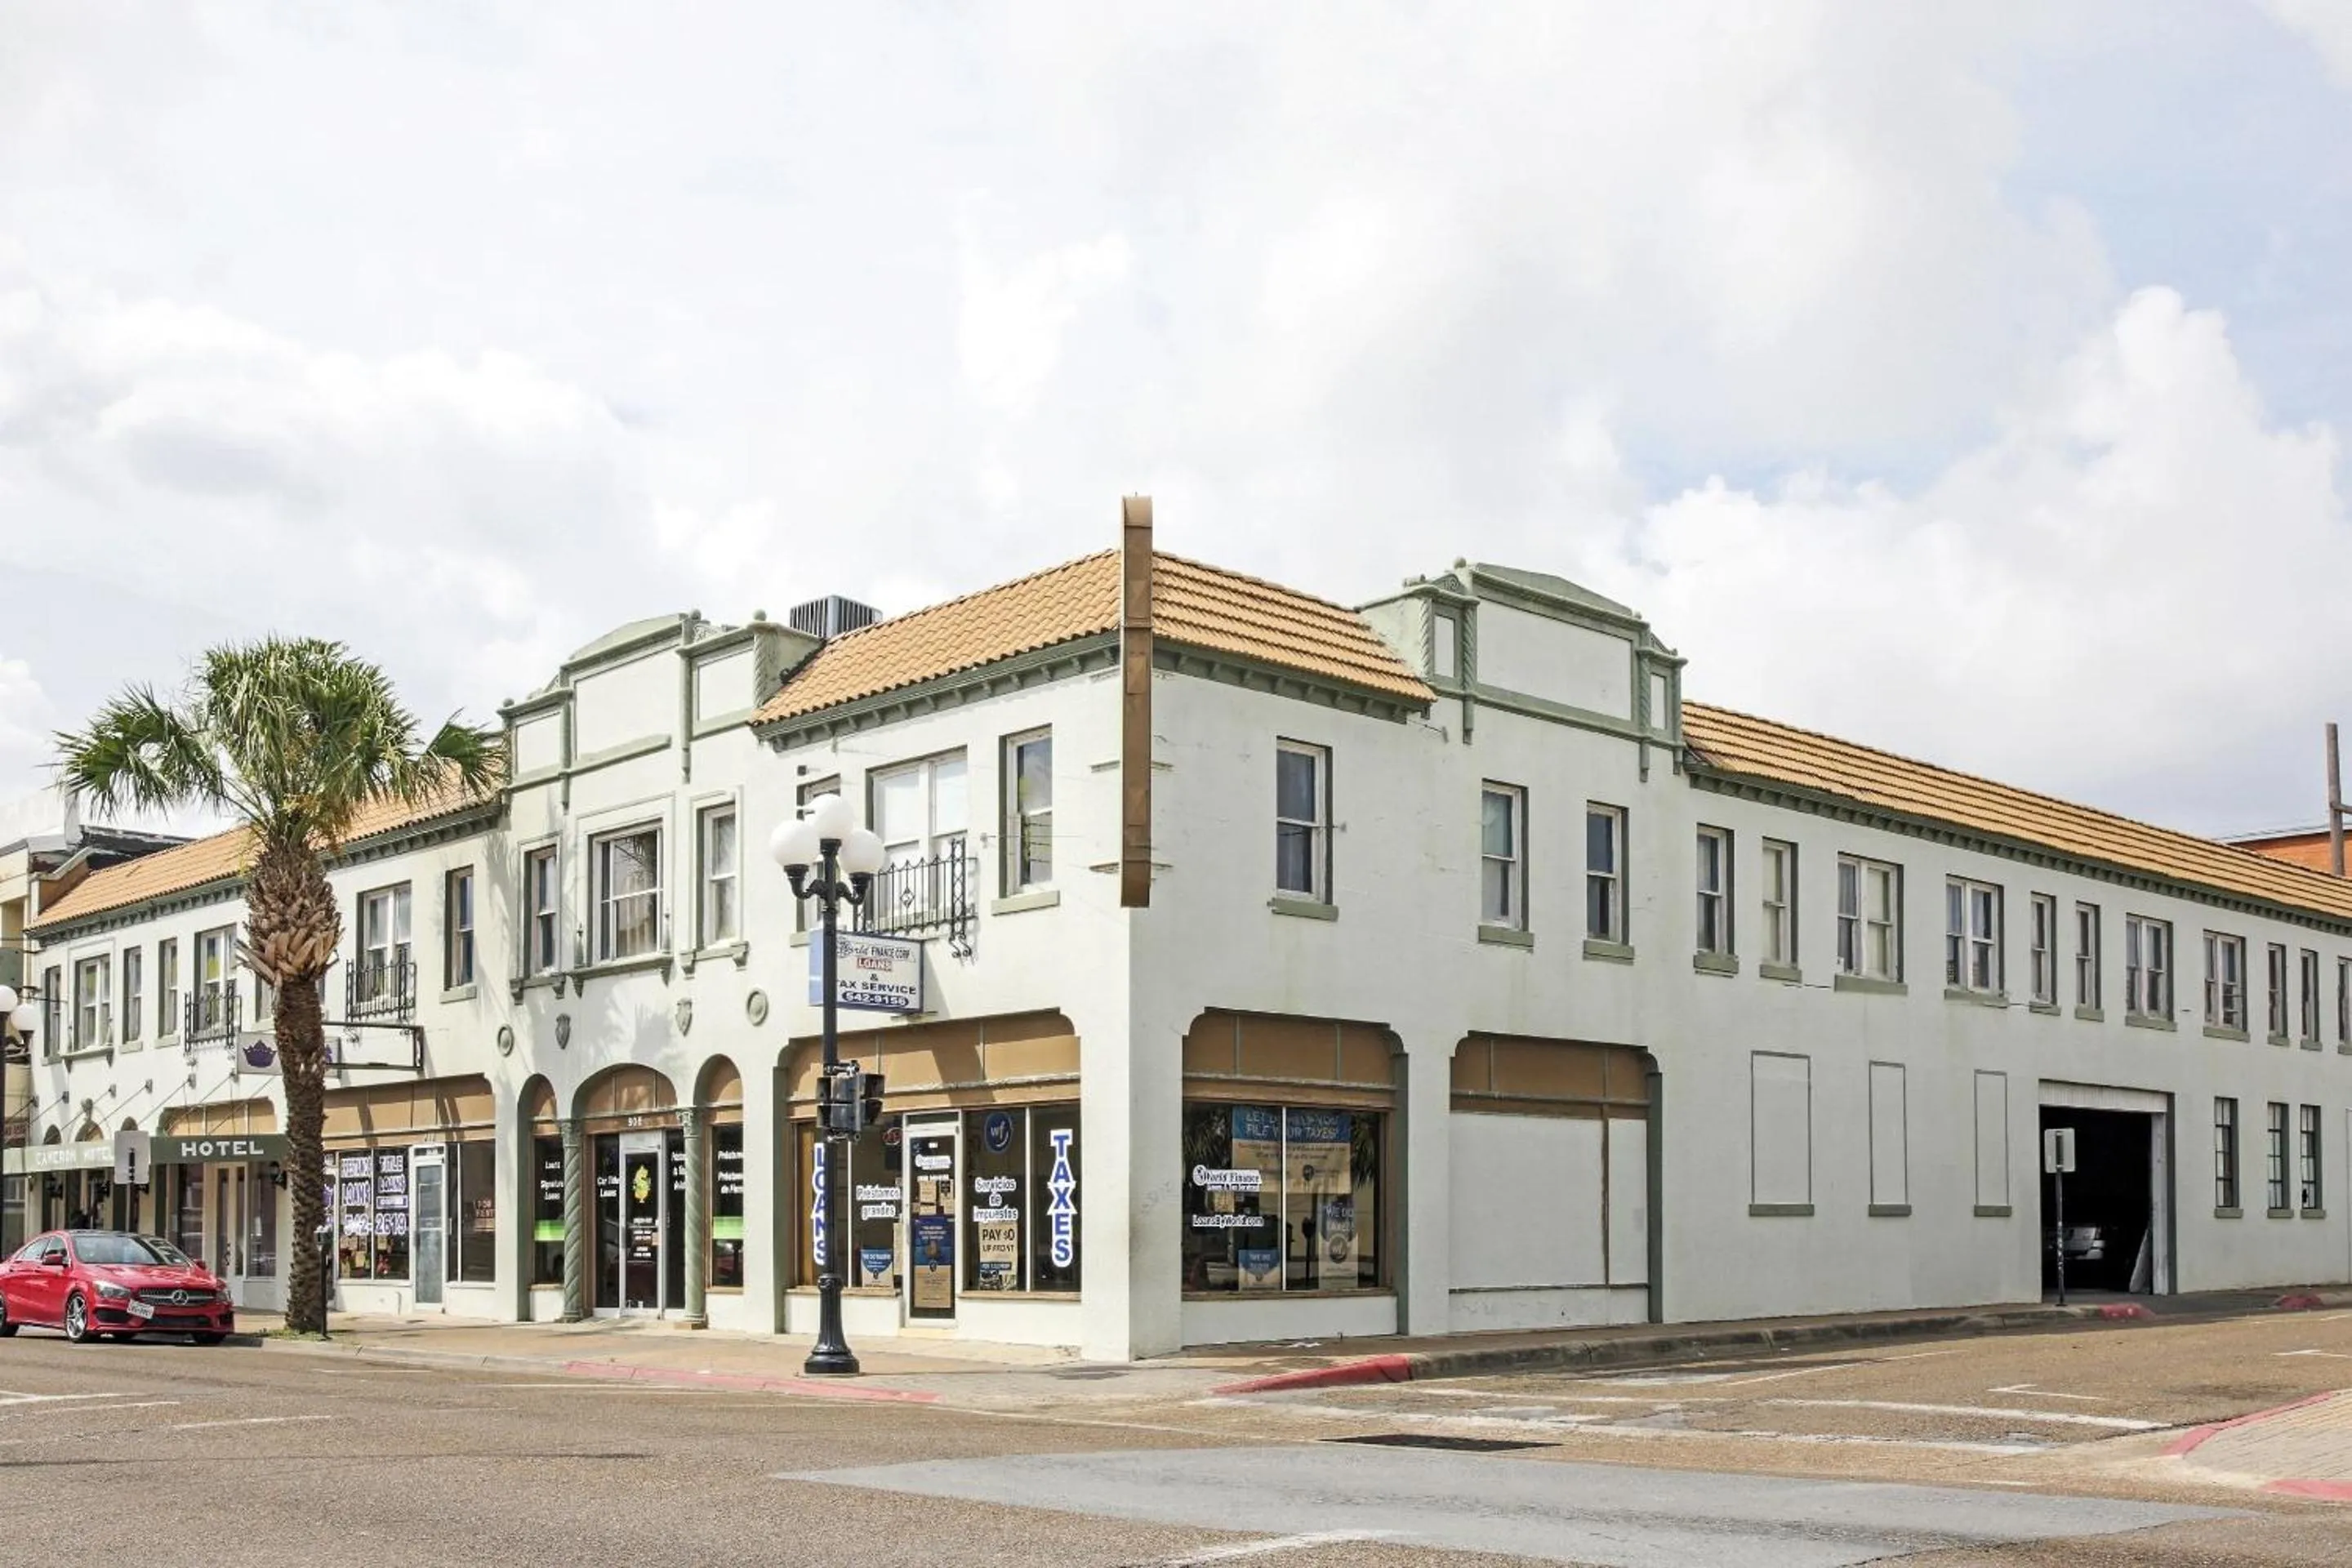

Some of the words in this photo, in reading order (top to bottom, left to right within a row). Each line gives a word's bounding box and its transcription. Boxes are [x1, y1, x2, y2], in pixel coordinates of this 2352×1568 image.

[857, 957, 893, 972] LOANS
[870, 973, 878, 982] &
[837, 980, 857, 989] AX
[862, 982, 916, 995] SERVICE
[1271, 1125, 1303, 1138] YUR
[180, 1141, 265, 1157] HOTEL
[378, 1175, 406, 1193] LOANS
[975, 1177, 1016, 1192] Servicios
[342, 1183, 371, 1206] LOANS
[989, 1192, 1002, 1206] de
[1050, 1131, 1073, 1264] TAXES
[862, 1203, 896, 1220] grandes
[982, 1229, 1002, 1241] PAY
[1003, 1228, 1015, 1241] $0
